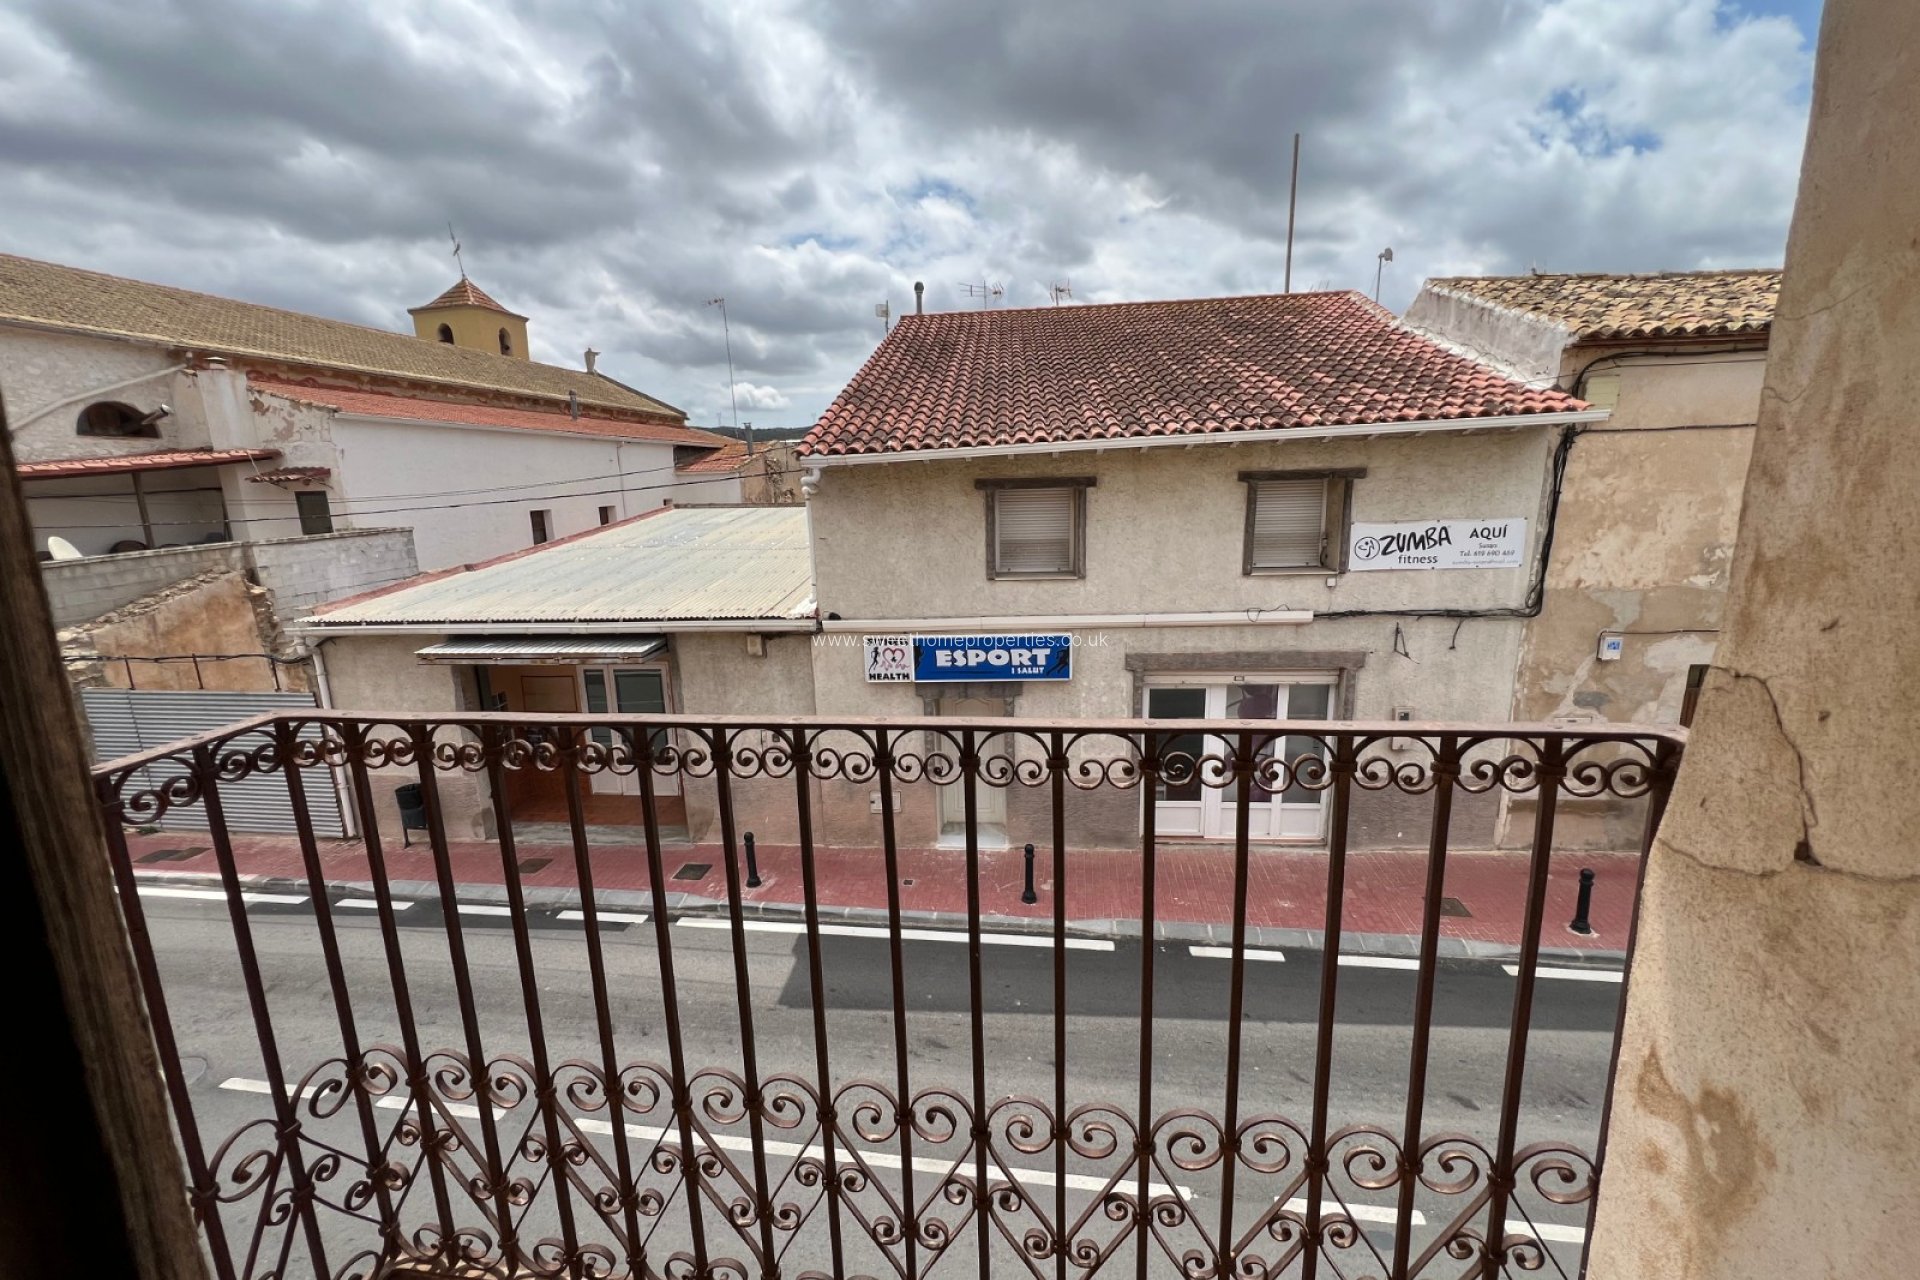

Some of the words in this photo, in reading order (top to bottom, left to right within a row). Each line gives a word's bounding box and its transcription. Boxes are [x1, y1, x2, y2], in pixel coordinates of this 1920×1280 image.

[1469, 523, 1508, 540] AQUÍ
[1379, 526, 1452, 556] ZUMBA
[1398, 554, 1438, 564] fitness
[936, 648, 1050, 667] ESPORT
[869, 673, 910, 681] HEALTH
